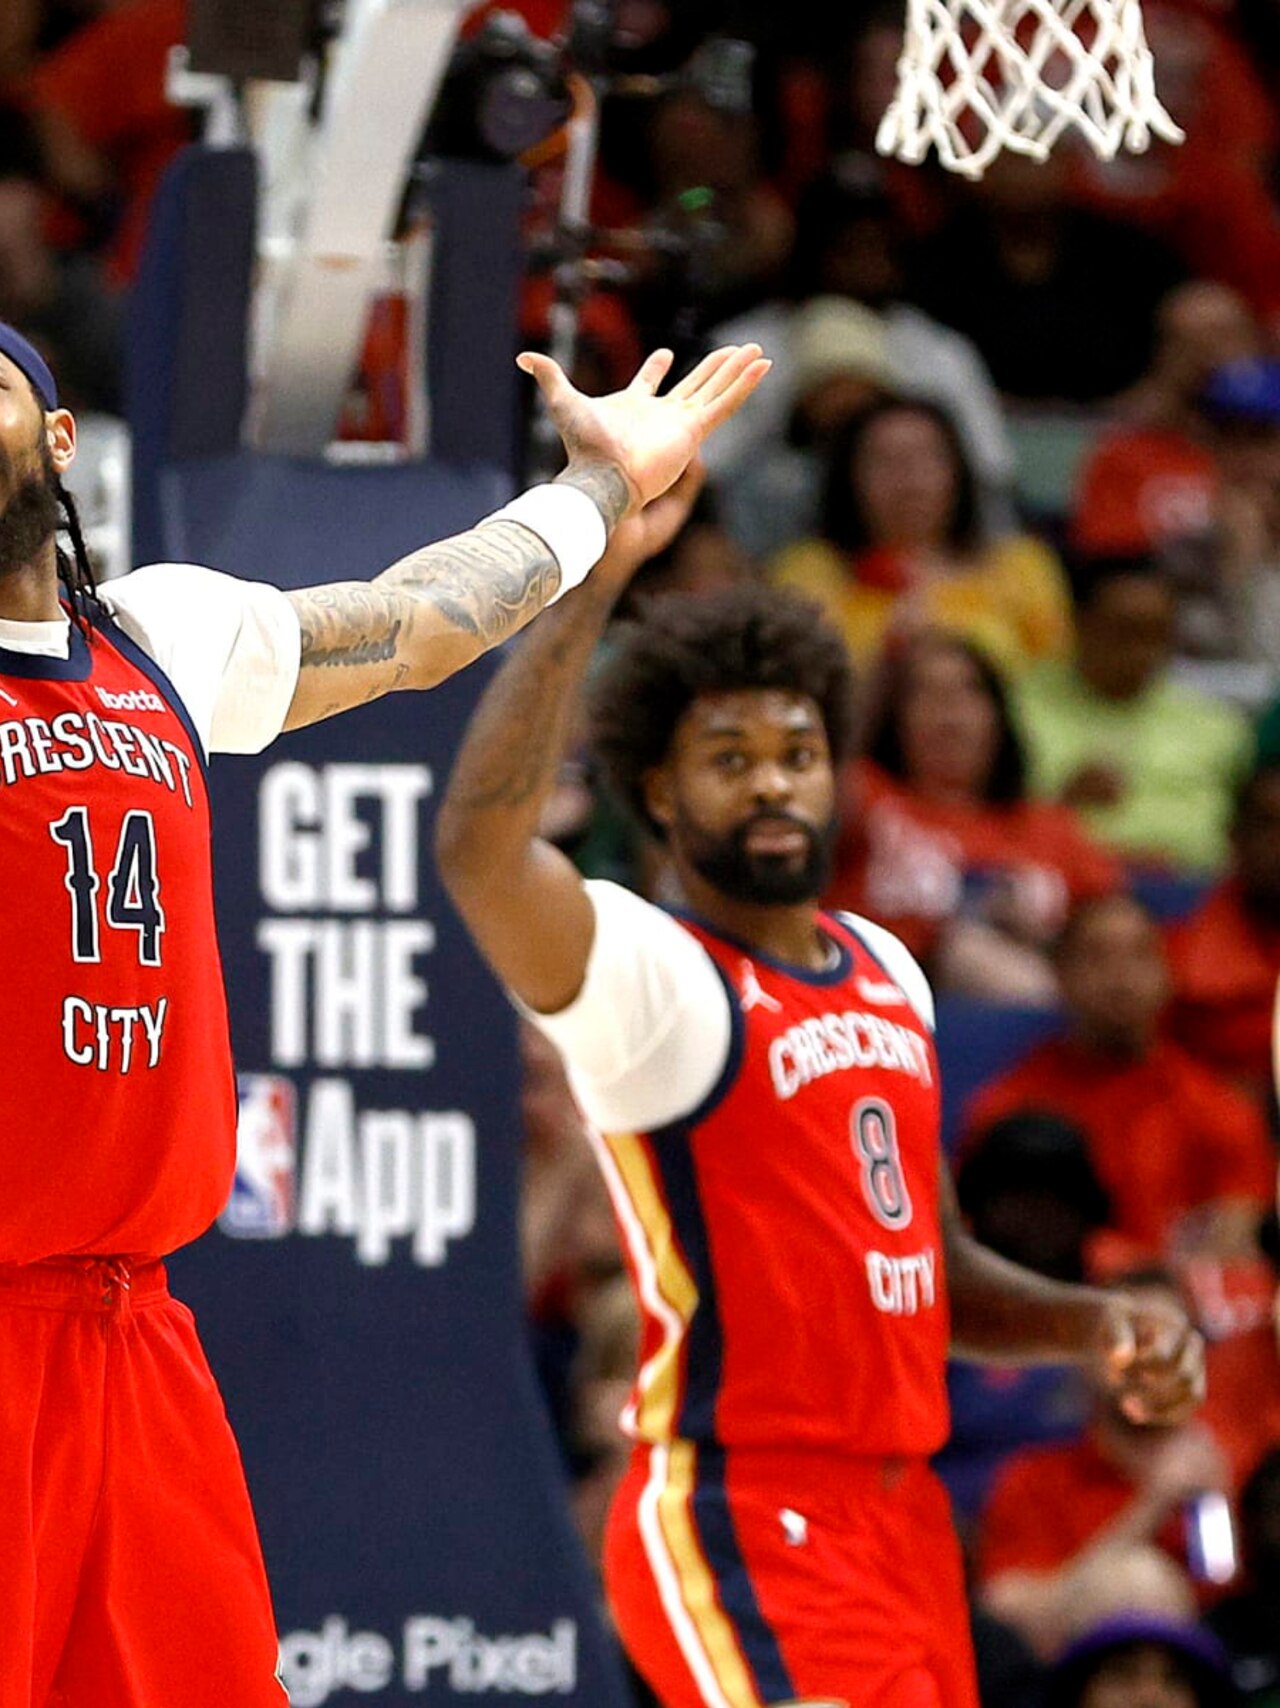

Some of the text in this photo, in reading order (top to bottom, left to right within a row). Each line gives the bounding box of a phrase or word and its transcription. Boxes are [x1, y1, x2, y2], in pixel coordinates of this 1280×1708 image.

[49, 805, 166, 968] 14
[258, 760, 433, 913] GET
[62, 996, 168, 1074] CITY
[256, 917, 436, 1069] THE
[768, 1010, 934, 1101] CRESCENT
[297, 1077, 477, 1268] App
[849, 1096, 914, 1232] 8
[865, 1247, 936, 1316] CITY
[278, 1613, 577, 1708] gle Pixel
